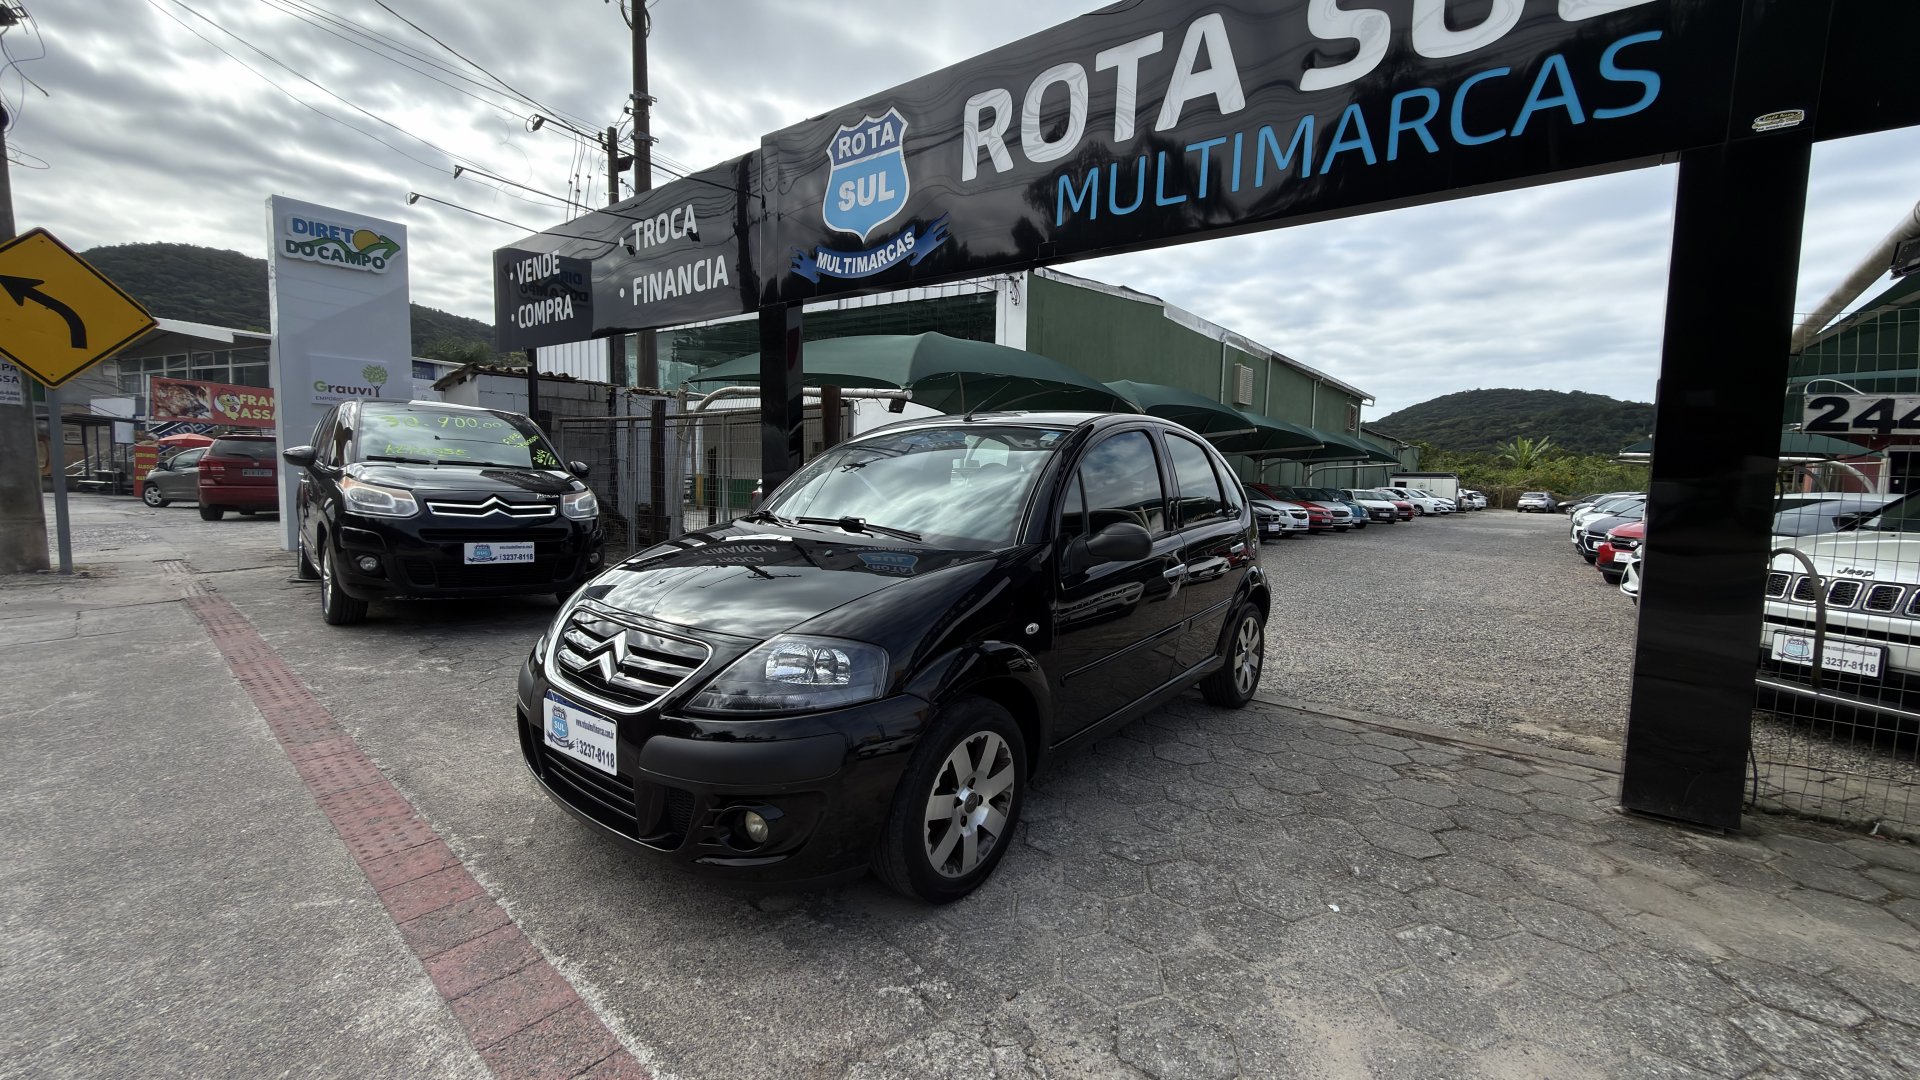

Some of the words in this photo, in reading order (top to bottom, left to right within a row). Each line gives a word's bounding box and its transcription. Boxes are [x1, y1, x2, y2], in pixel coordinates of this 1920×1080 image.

[962, 13, 1246, 181] ROTA
[1300, 0, 1656, 91] SU
[838, 121, 896, 160] ROTA
[1056, 30, 1663, 227] MULTIMARCAS
[838, 170, 895, 212] SUL
[631, 203, 698, 251] TROCA
[317, 246, 386, 270] CAMPO
[516, 250, 561, 285] VENDE
[816, 231, 916, 275] MULTIMARCAS
[632, 254, 729, 306] FINANCIA
[518, 294, 574, 329] COMPRA
[240, 407, 276, 420] ASS
[1836, 567, 1874, 578] Jeep
[1825, 656, 1877, 673] 3237-8118
[553, 719, 566, 732] SUL
[579, 740, 615, 768] 3237-8118
